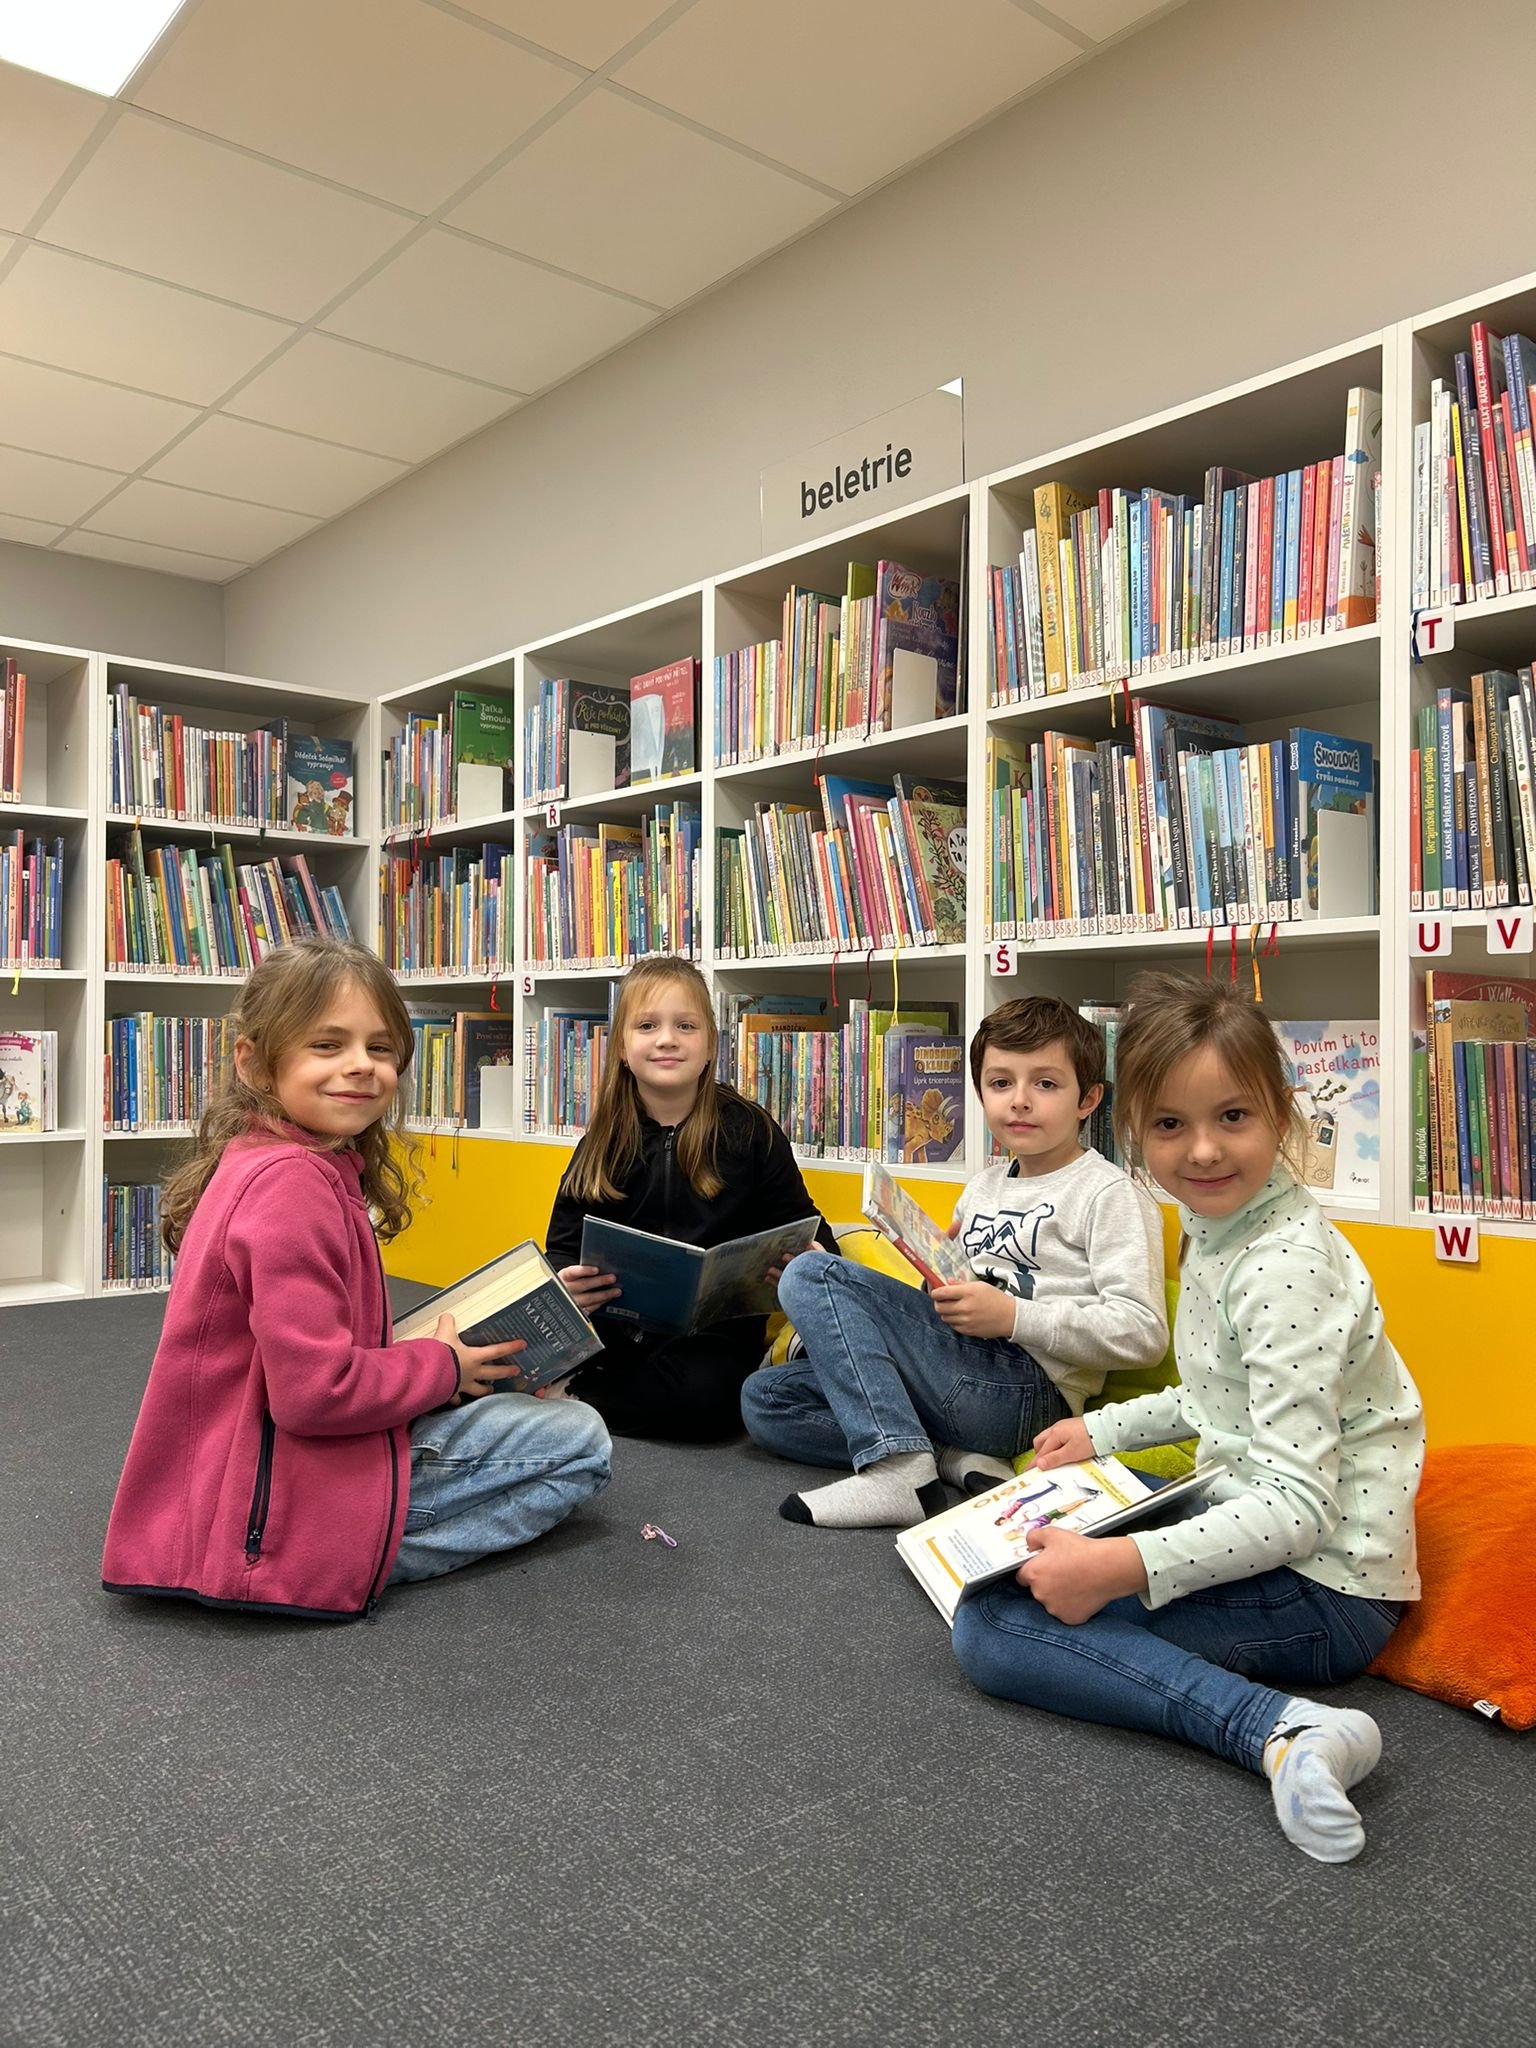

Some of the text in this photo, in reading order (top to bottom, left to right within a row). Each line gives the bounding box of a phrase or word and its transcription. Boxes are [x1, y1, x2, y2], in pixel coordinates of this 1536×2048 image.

[1478, 380, 1488, 404] RÁDCE
[1481, 406, 1491, 430] VELKÝ
[801, 443, 912, 518] beletrie
[1421, 617, 1442, 649] T
[1314, 740, 1360, 773] ŠMOULOVÉ
[1490, 721, 1500, 764] Chaloupka
[1423, 747, 1438, 854] Ukrajinské lidové pohádky
[1440, 724, 1452, 859] KRÁSNÉ PŘÍBĚHY PANÍ KRÁLÍČKOVÉ
[1468, 778, 1478, 836] POD HVĚZDAMI
[549, 805, 557, 825] Ř
[1483, 813, 1492, 847] Chaloupka
[1418, 922, 1440, 952] U
[1496, 918, 1521, 949] V
[996, 944, 1010, 973] Š
[524, 977, 531, 993] S
[1294, 1031, 1377, 1055] Povím ti to
[926, 1060, 950, 1072] KLUB
[1297, 1052, 1380, 1081] pastelkami
[1416, 1127, 1427, 1162] medvědů
[1416, 1163, 1427, 1183] Král
[1438, 1226, 1471, 1257] W
